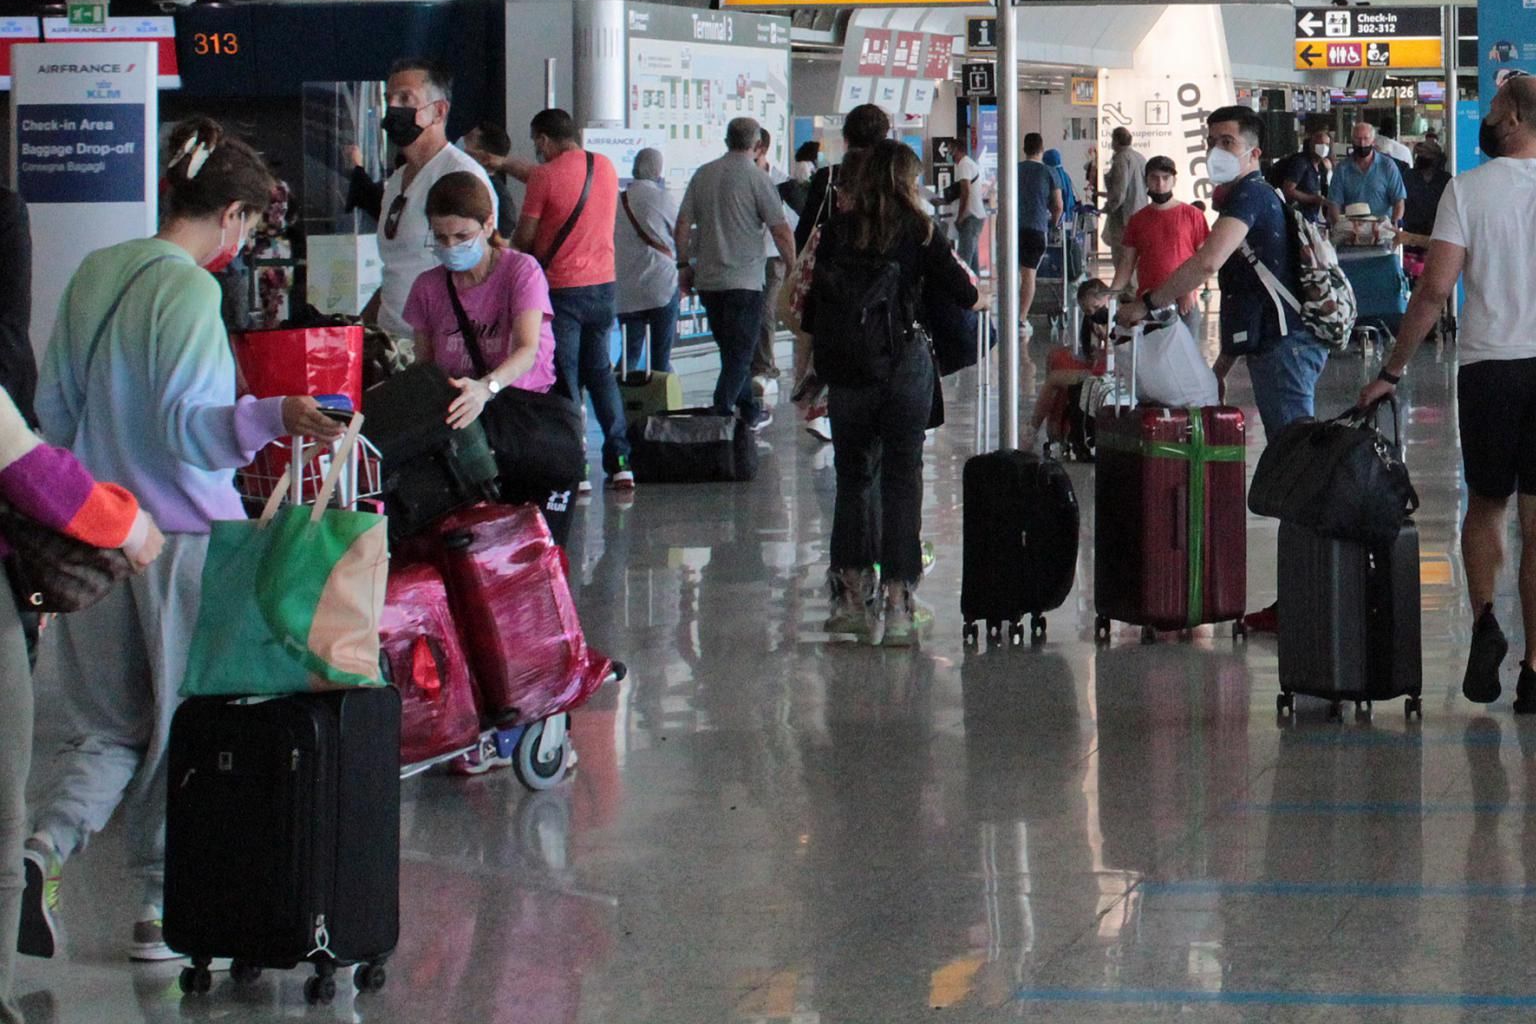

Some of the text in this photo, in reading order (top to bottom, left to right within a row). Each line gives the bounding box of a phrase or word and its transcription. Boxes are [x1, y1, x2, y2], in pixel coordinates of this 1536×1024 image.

[1357, 13, 1397, 23] Check-in
[692, 14, 727, 41] Terminal
[727, 17, 733, 41] 3
[1357, 24, 1396, 33] 302-312
[194, 33, 239, 55] 313
[37, 64, 121, 74] AIRFRANCE
[86, 90, 121, 98] KLM
[22, 118, 114, 131] Check-in Area
[21, 142, 135, 157] Baggage Drop-off
[546, 502, 567, 513] RUN
